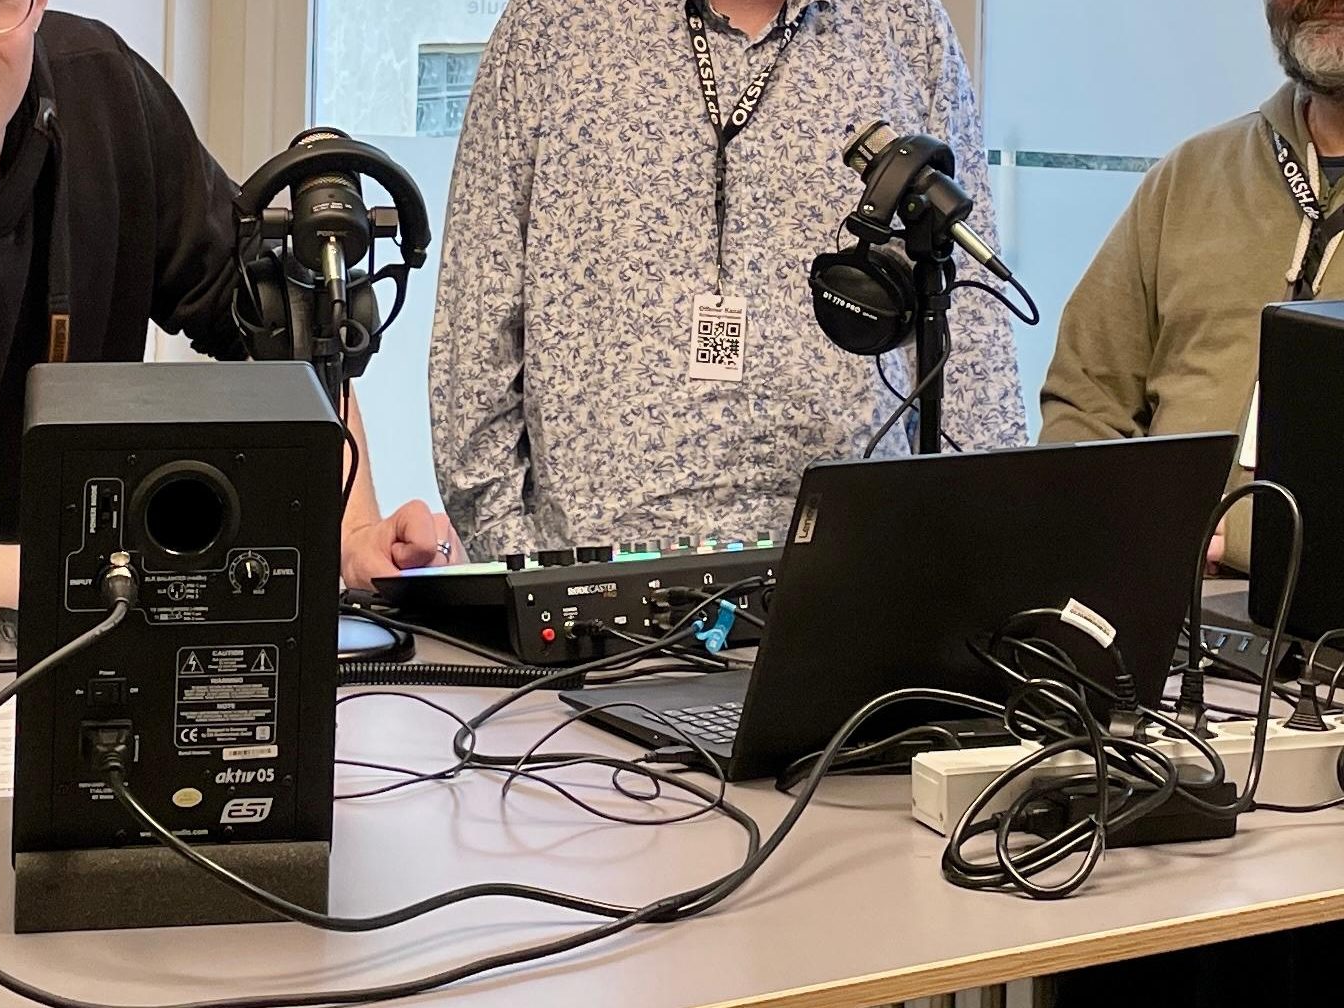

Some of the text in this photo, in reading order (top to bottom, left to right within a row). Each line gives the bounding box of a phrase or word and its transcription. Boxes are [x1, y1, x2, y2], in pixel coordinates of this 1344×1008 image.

[693, 35, 719, 125] OKSH.de
[1283, 161, 1319, 220] OKSH.de
[215, 767, 275, 784] aktiv 05
